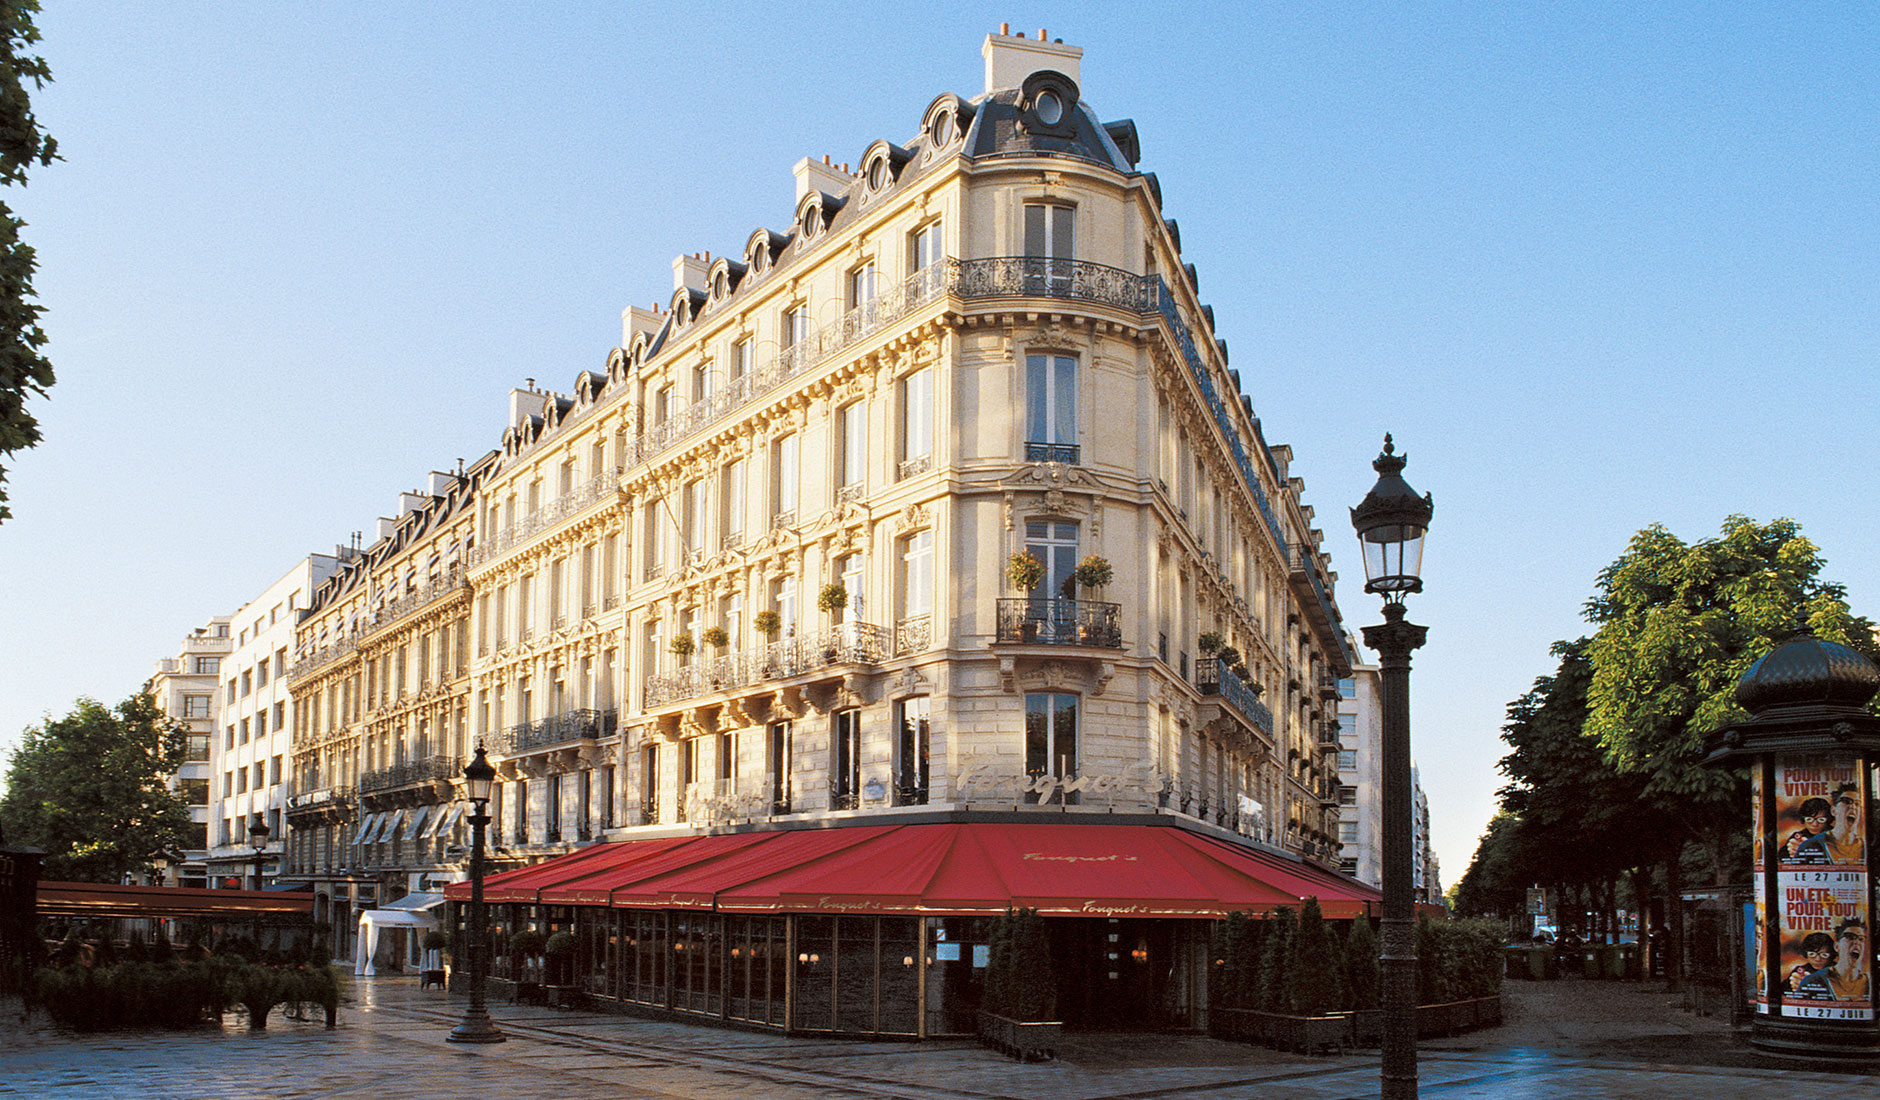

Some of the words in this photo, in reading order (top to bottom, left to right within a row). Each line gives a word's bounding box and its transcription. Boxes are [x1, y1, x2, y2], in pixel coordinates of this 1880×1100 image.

[1784, 768, 1820, 782] POUR
[1823, 768, 1854, 781] TOUT
[1794, 873, 1806, 881] LE
[1815, 873, 1829, 881] 27
[1836, 873, 1860, 882] JUIN
[1786, 888, 1804, 901] UN
[1786, 902, 1824, 916] POUR
[1826, 903, 1858, 917] TOUT
[1797, 1008, 1809, 1016] LE
[1817, 1009, 1832, 1018] 27
[1839, 1010, 1864, 1019] JUIN
